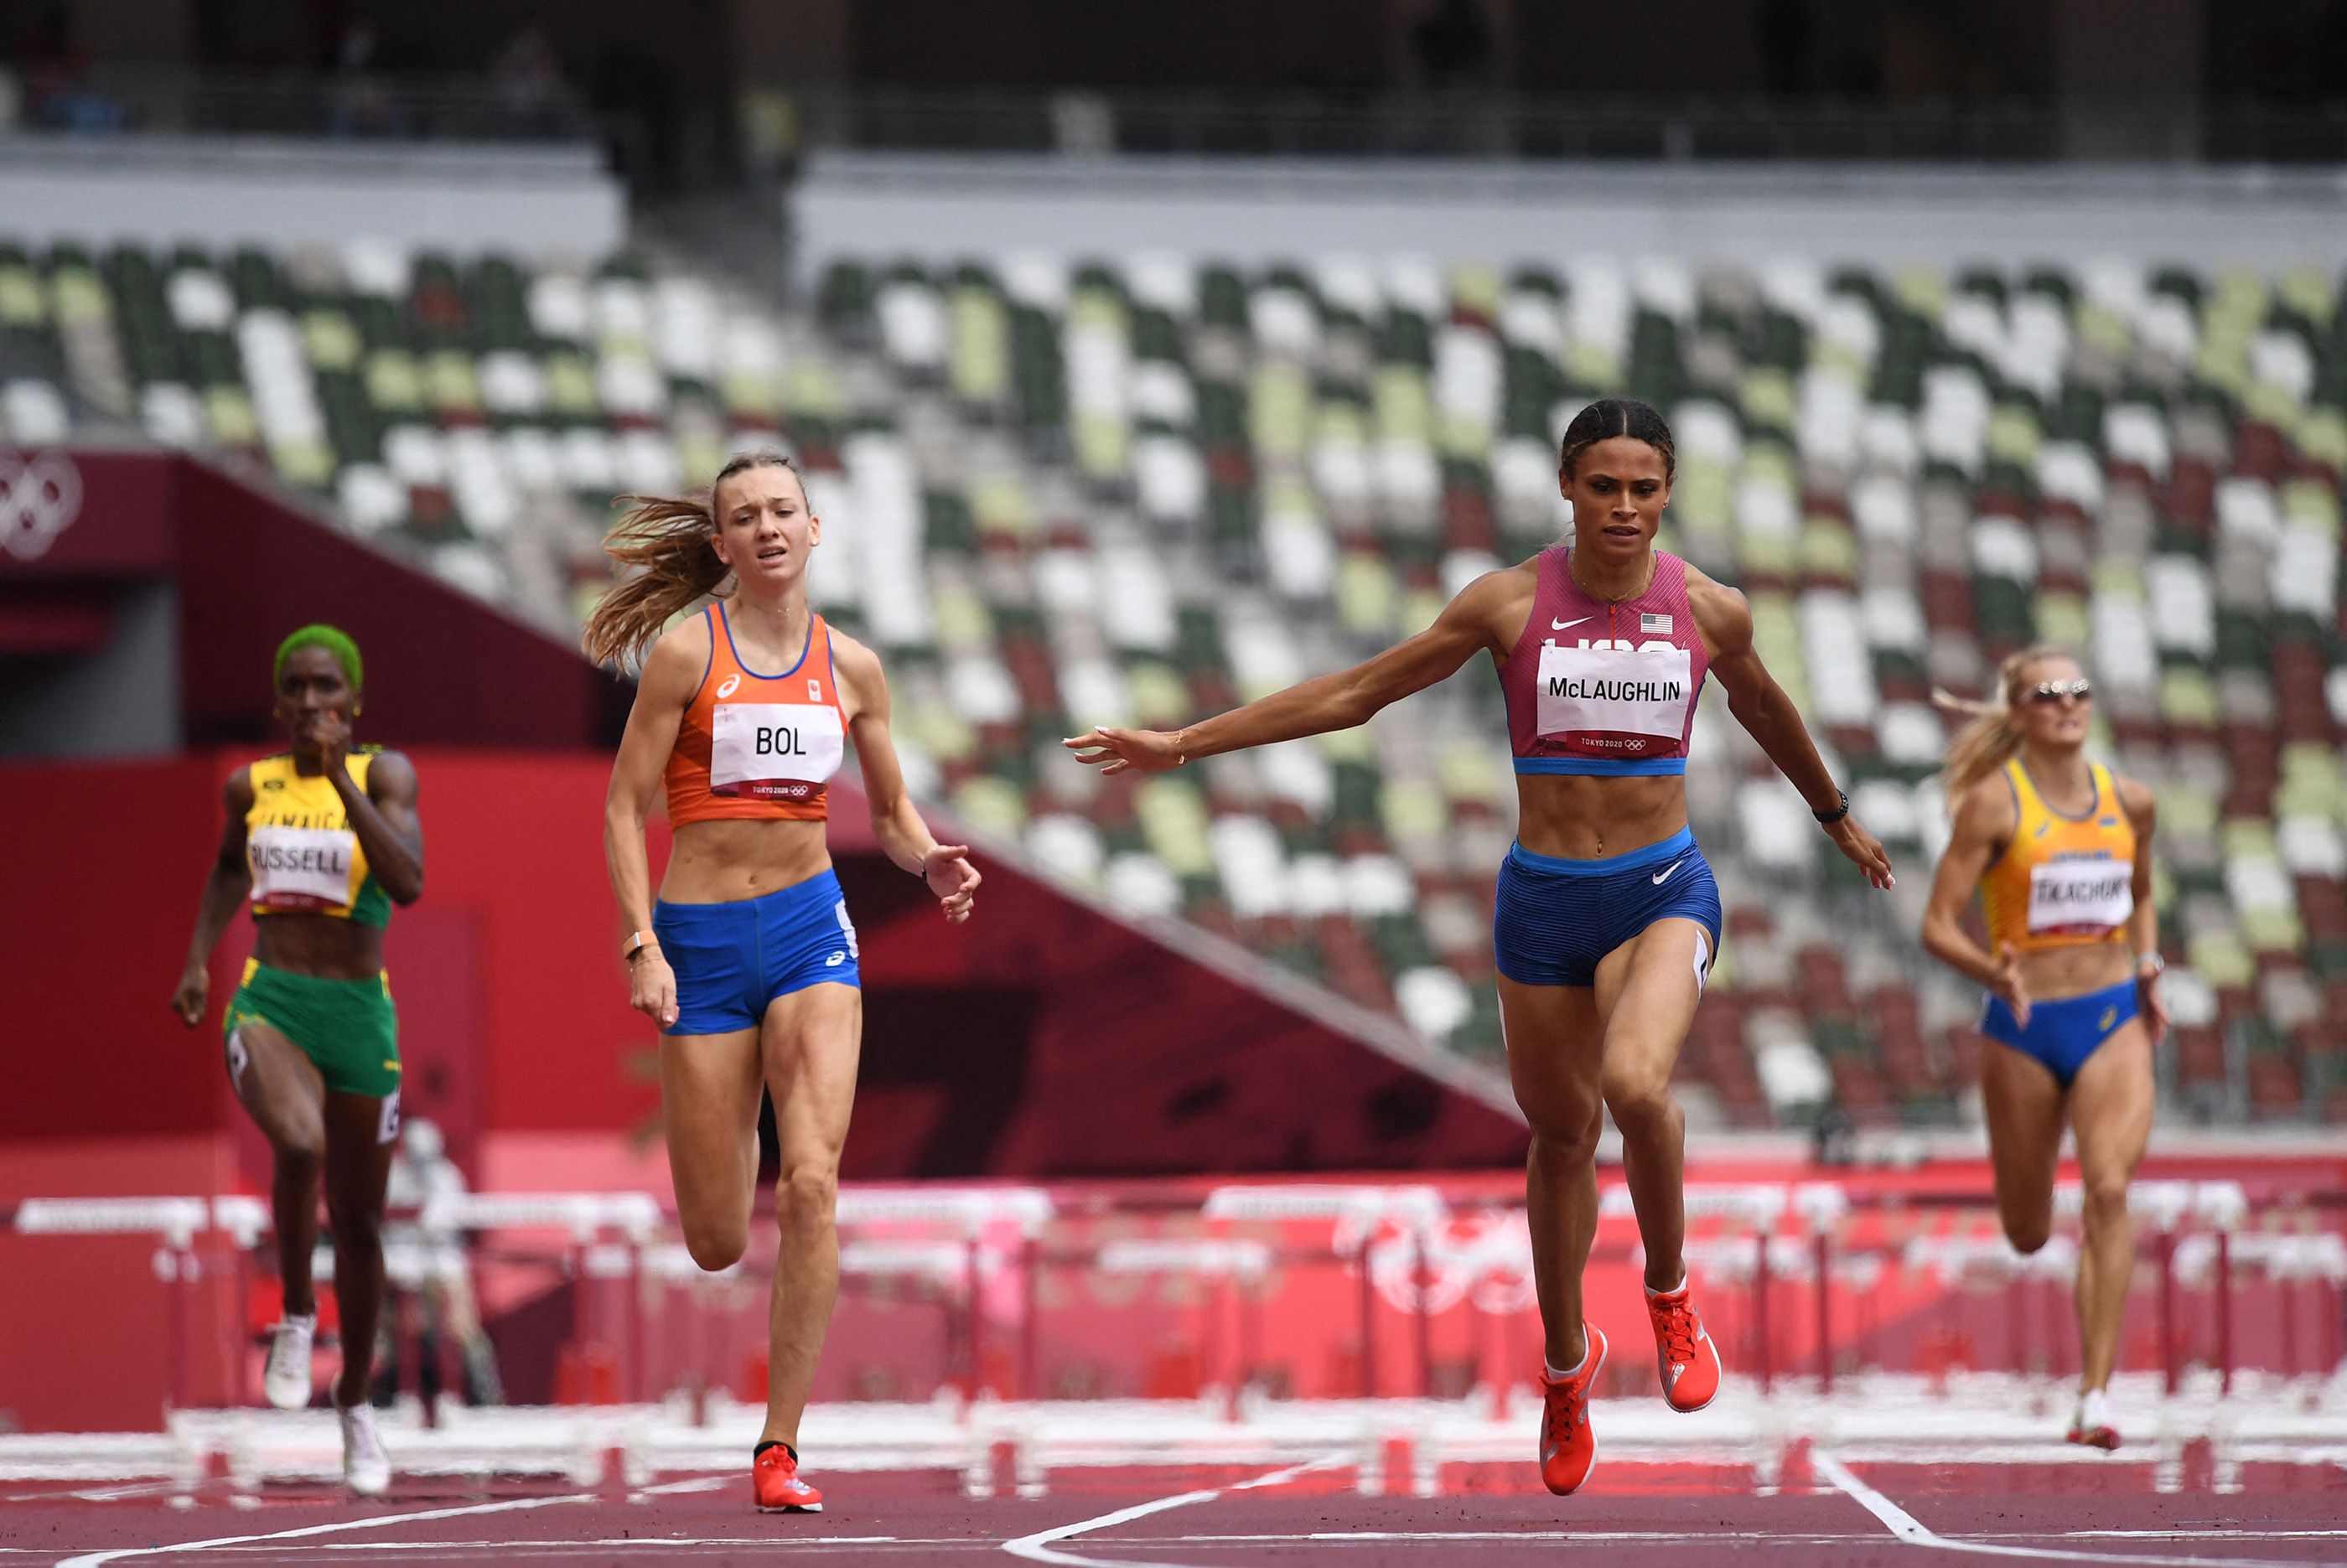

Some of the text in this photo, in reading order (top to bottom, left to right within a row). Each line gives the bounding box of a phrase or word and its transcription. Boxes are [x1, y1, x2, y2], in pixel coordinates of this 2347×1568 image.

[1549, 676, 1681, 702] McLAUGHLIN
[756, 727, 806, 755] BOL
[1581, 737, 1623, 748] TOKYO 2020
[774, 786, 789, 794] 2020
[252, 844, 345, 876] RUSSELL
